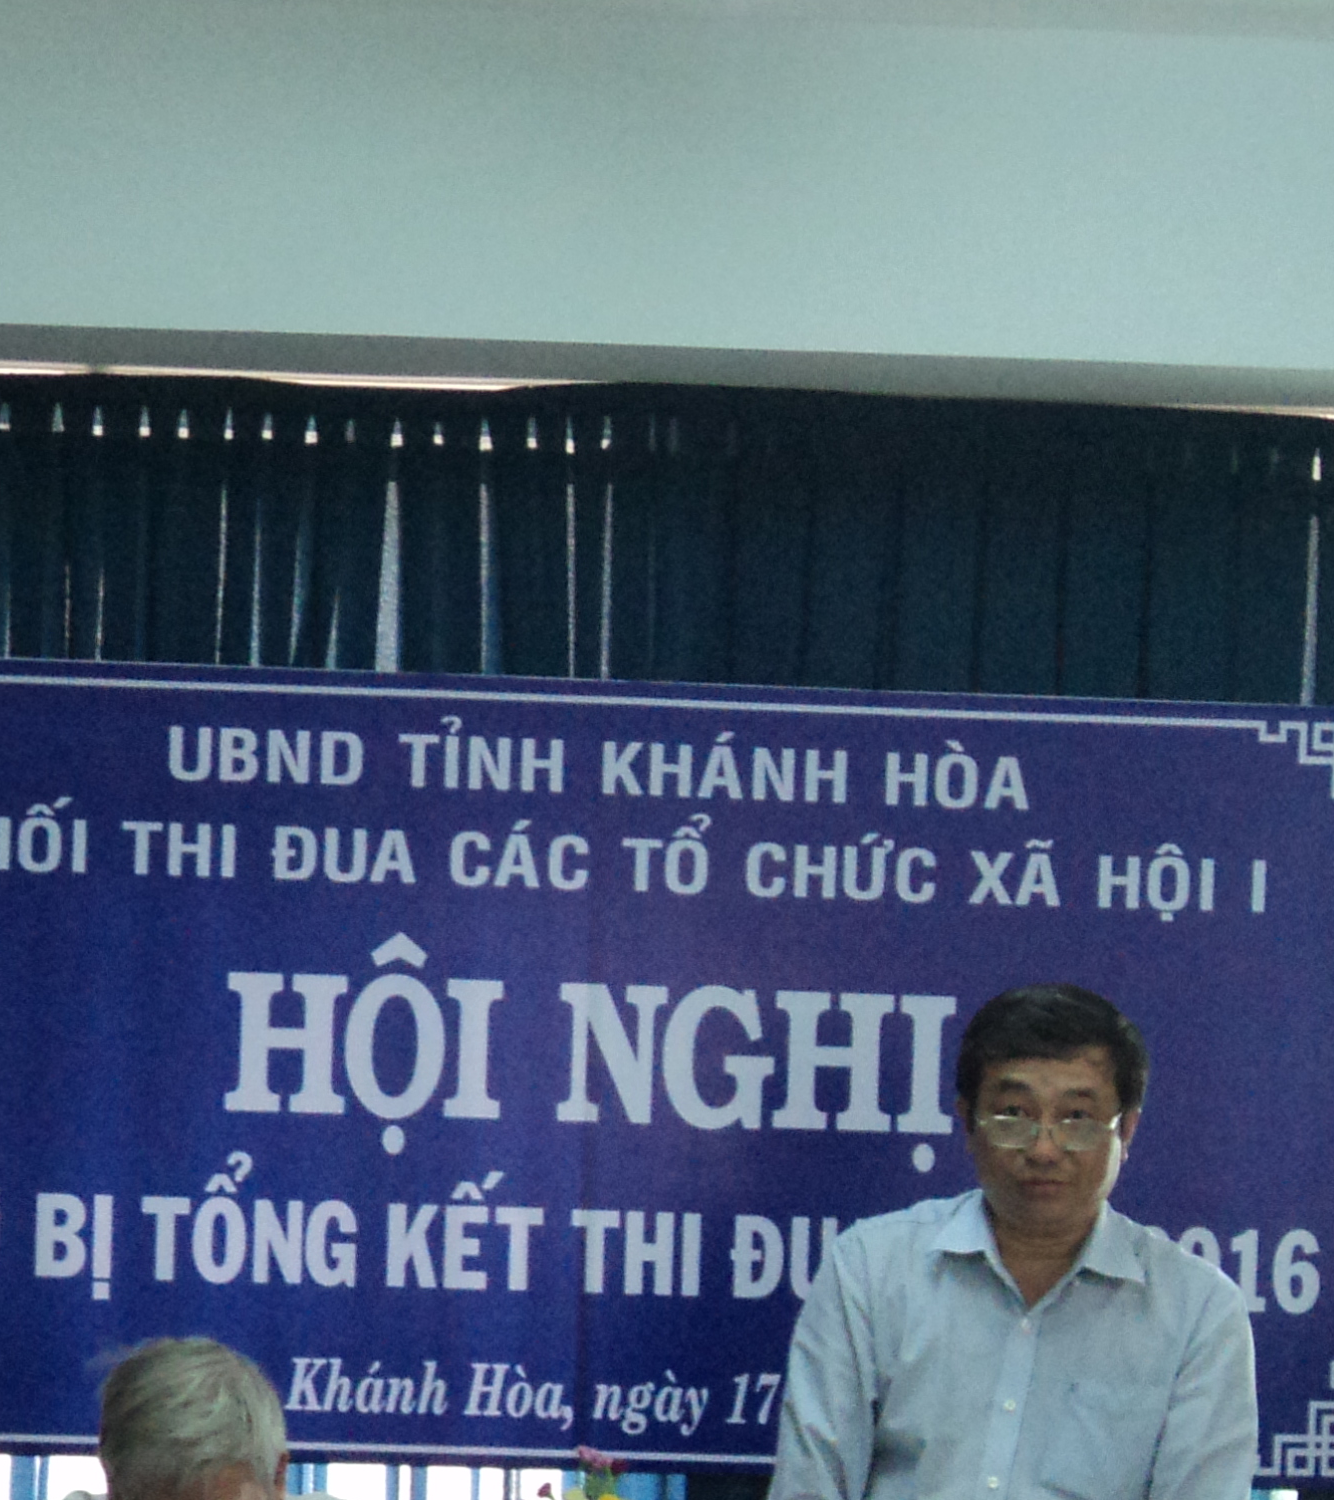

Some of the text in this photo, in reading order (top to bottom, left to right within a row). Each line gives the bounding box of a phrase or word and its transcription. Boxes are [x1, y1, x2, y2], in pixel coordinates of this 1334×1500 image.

[168, 715, 1029, 810] UBND TỈNH KHÁNH HÒA
[122, 820, 237, 878] THI
[272, 825, 416, 884] ĐUA
[449, 820, 589, 891] CÁC
[621, 813, 712, 895] TỔ
[745, 832, 936, 904] CHỨC
[968, 839, 1060, 906] XÃ
[1097, 843, 1215, 921] HỘI
[1251, 859, 1267, 913] I
[224, 932, 957, 1173] HỘI NGHỊ
[34, 1192, 114, 1300] BỊ
[141, 1151, 358, 1288] TỔNG
[386, 1170, 544, 1291] KẾT
[571, 1209, 701, 1296] THI
[730, 1214, 838, 1301] ĐU
[1145, 1225, 1321, 1315] 16
[284, 1356, 781, 1437] Khánh Hòa, ngày 17
